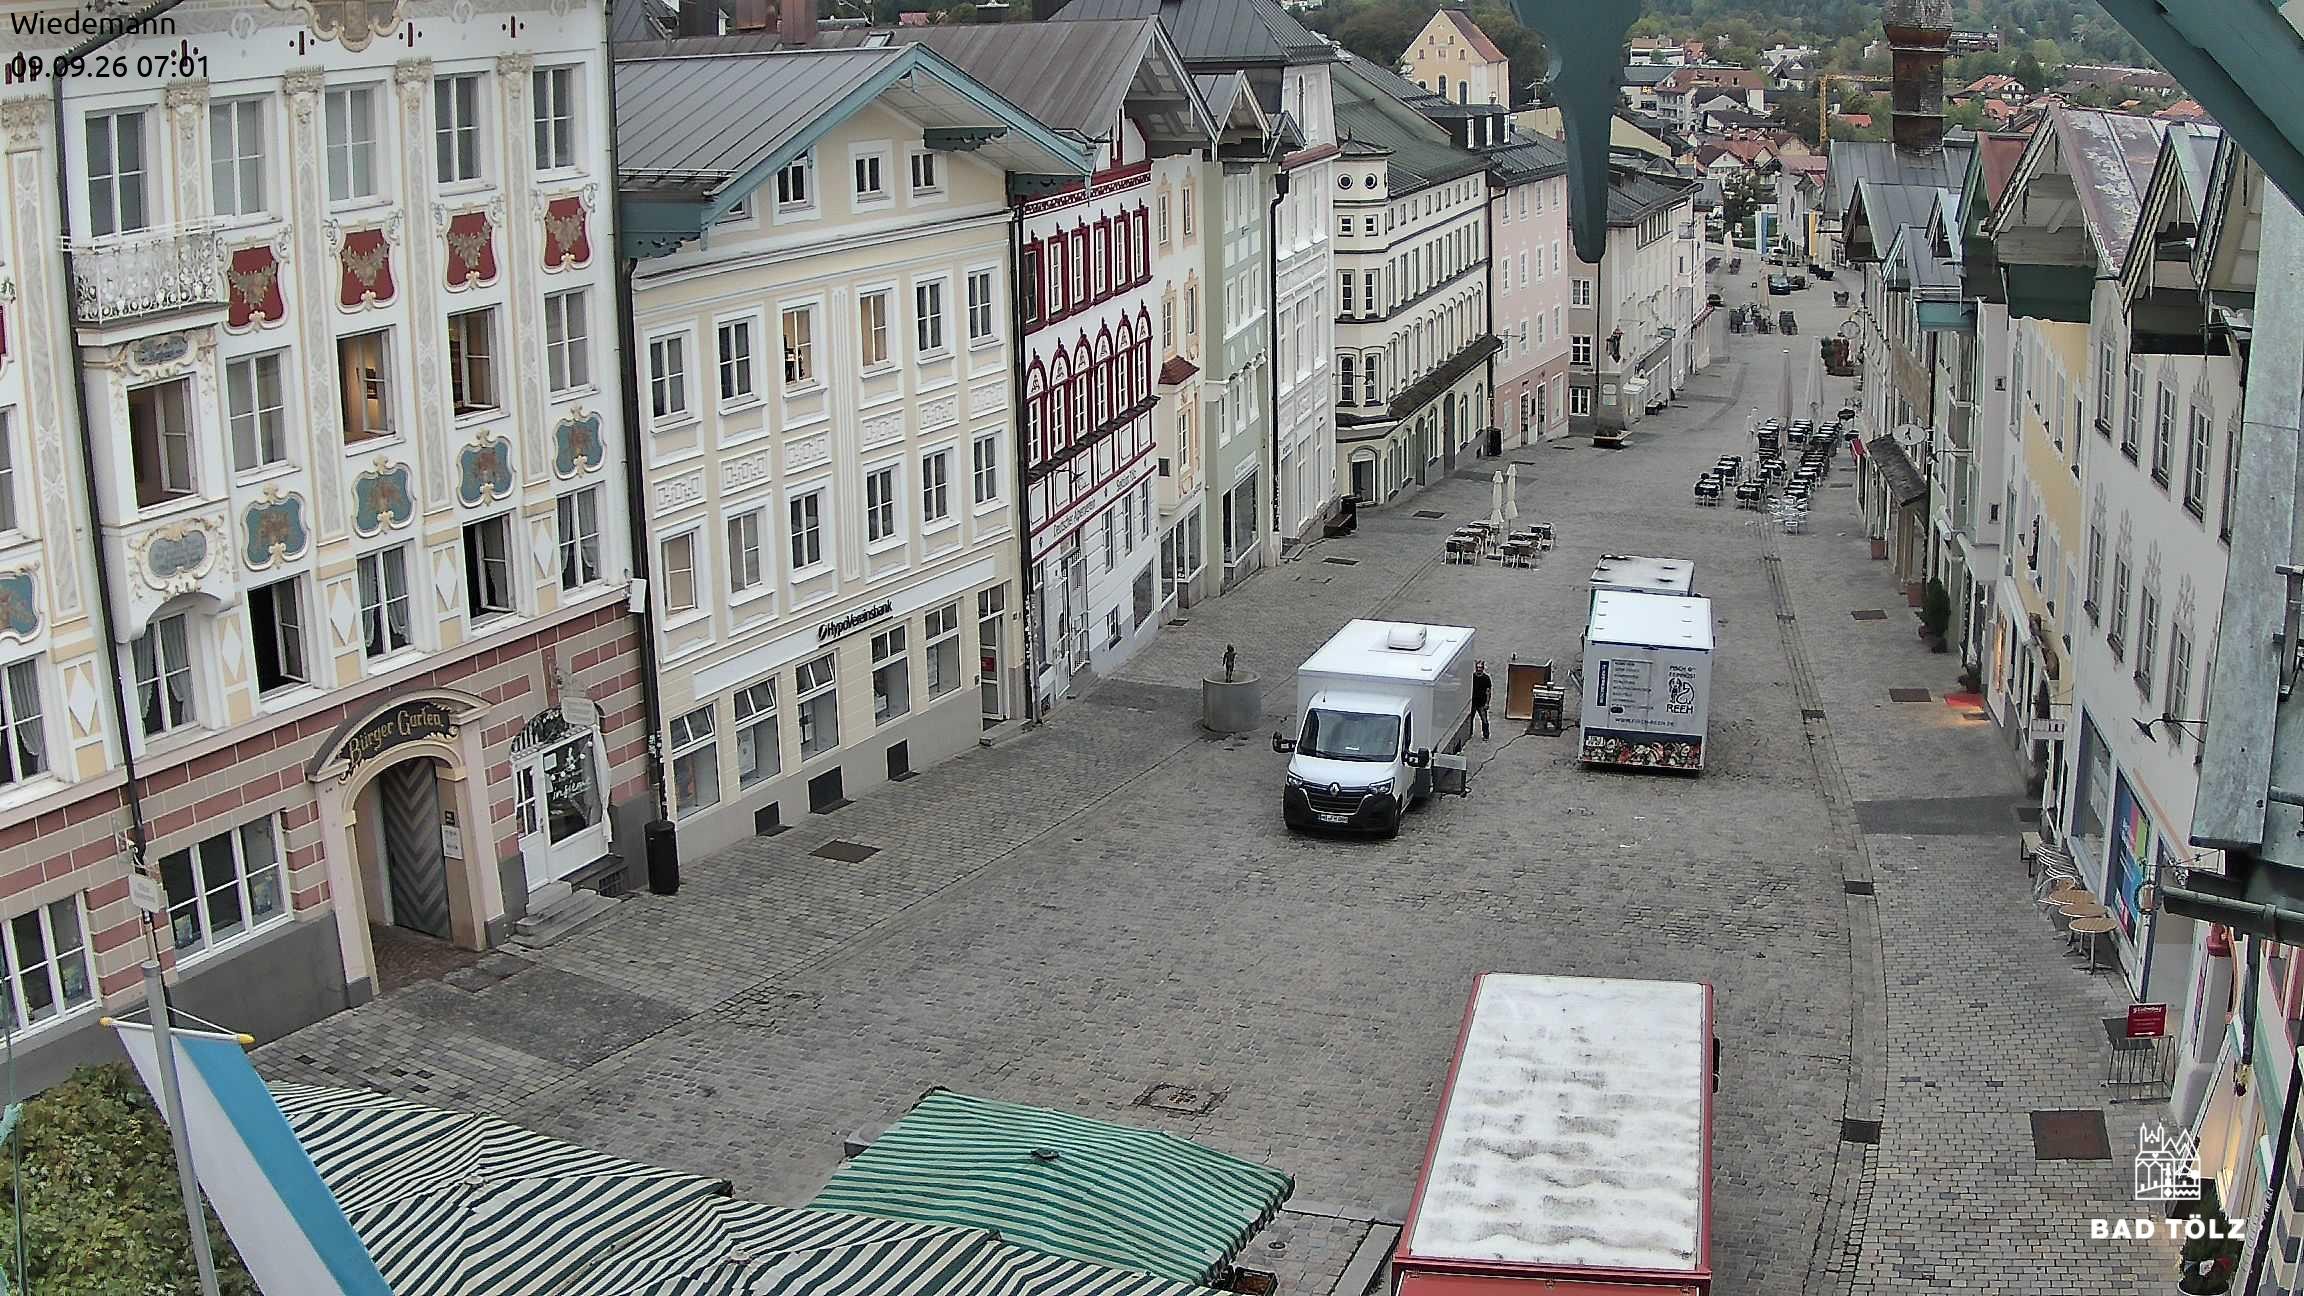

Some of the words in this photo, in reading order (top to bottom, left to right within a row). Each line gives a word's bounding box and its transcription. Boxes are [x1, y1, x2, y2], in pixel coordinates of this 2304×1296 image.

[827, 599, 892, 638] HypoVereinsbank
[1666, 703, 1694, 715] REEH
[349, 722, 394, 763] Bürger
[397, 706, 441, 736] Garten
